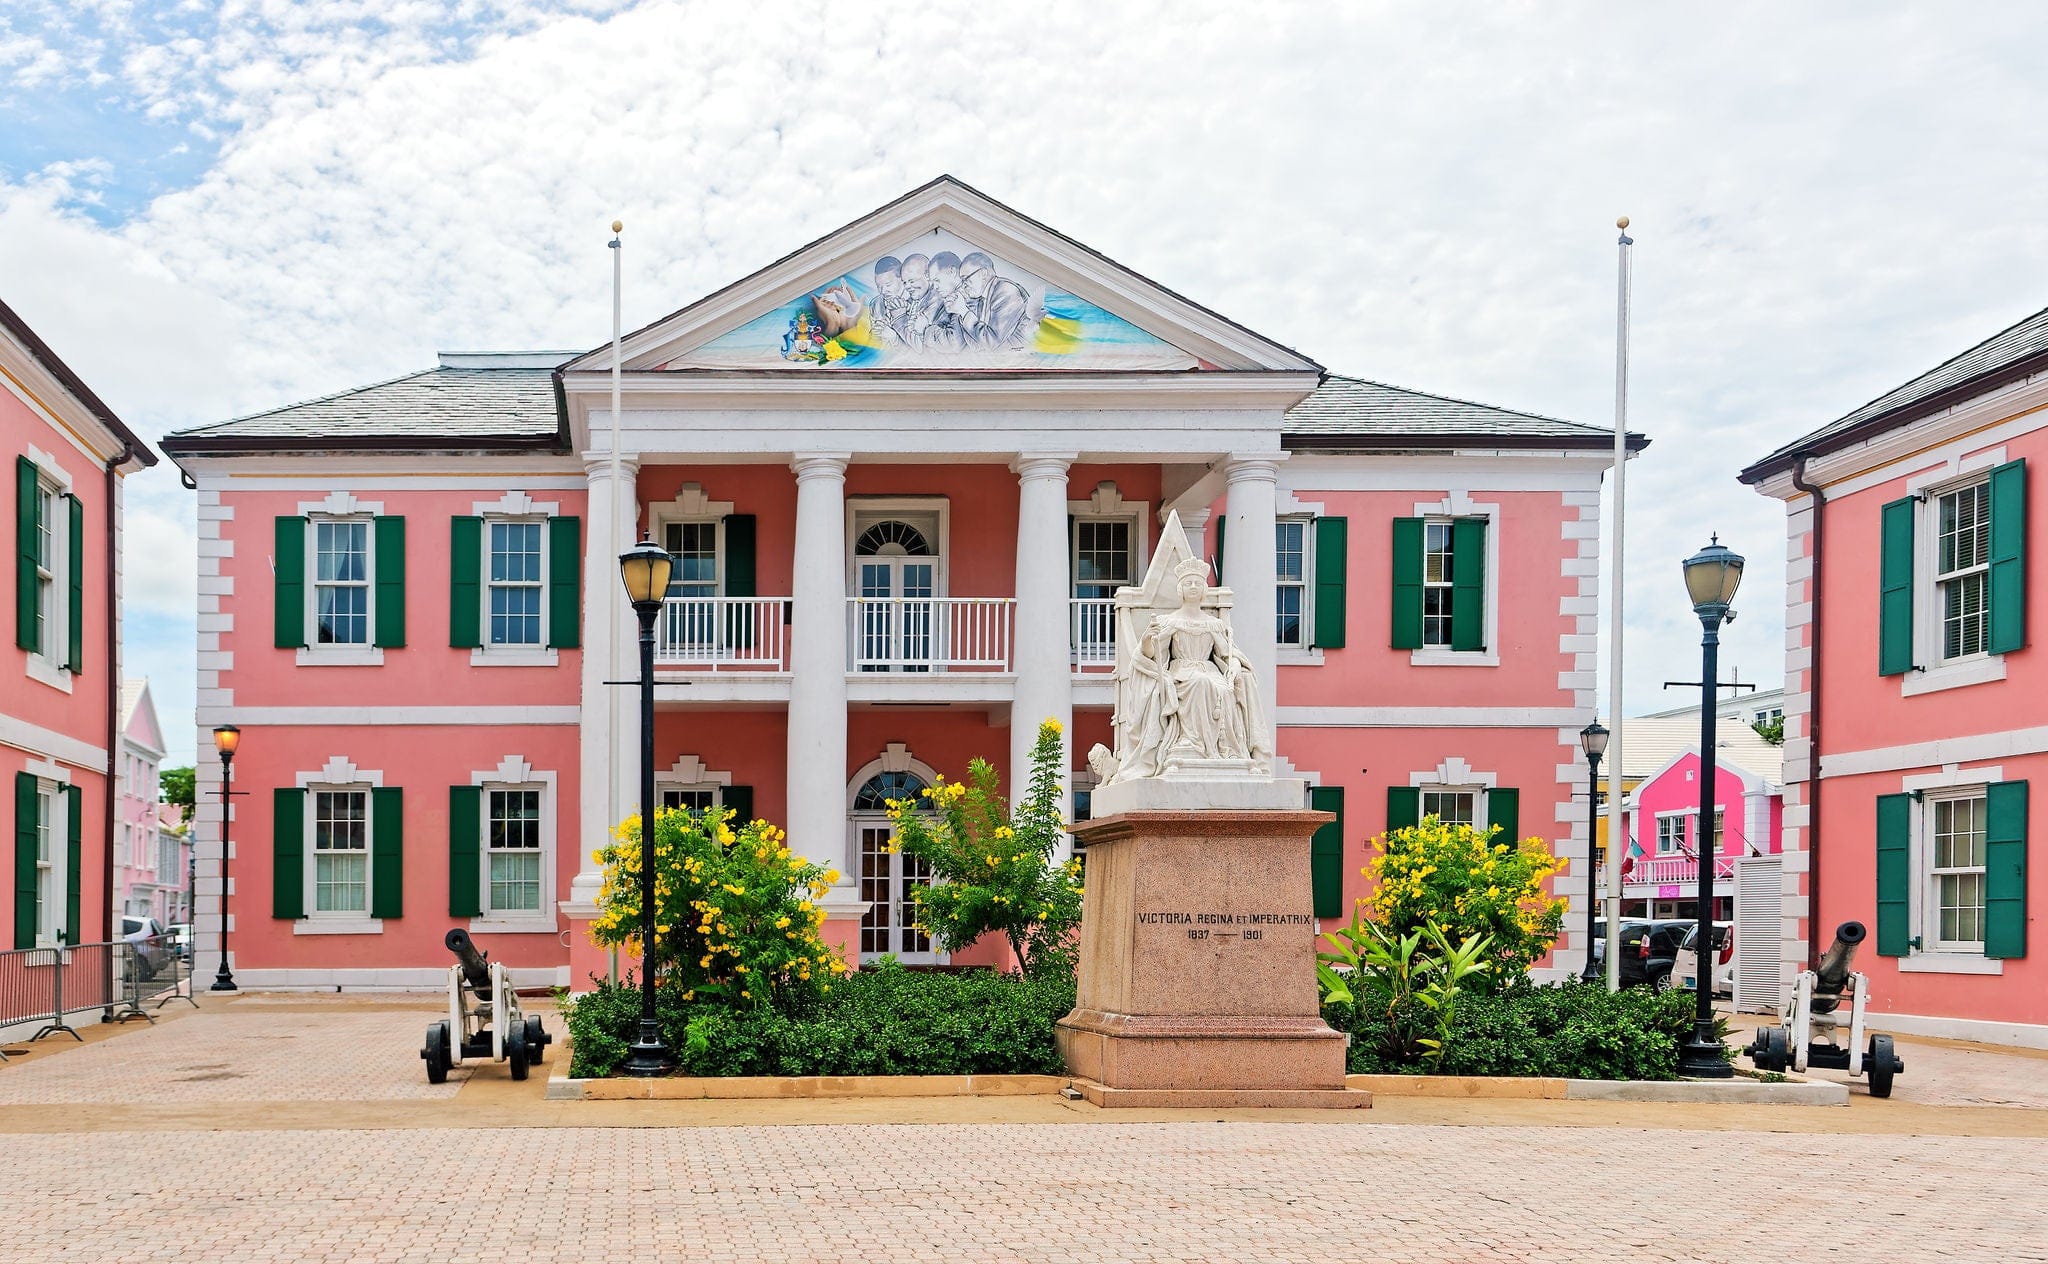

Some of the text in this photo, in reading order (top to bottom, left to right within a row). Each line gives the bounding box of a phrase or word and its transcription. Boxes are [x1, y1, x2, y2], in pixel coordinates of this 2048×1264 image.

[1138, 912, 1311, 925] VICTORIA REGINA ET IMPERATRIX
[1188, 929, 1263, 940] 1837 1901
